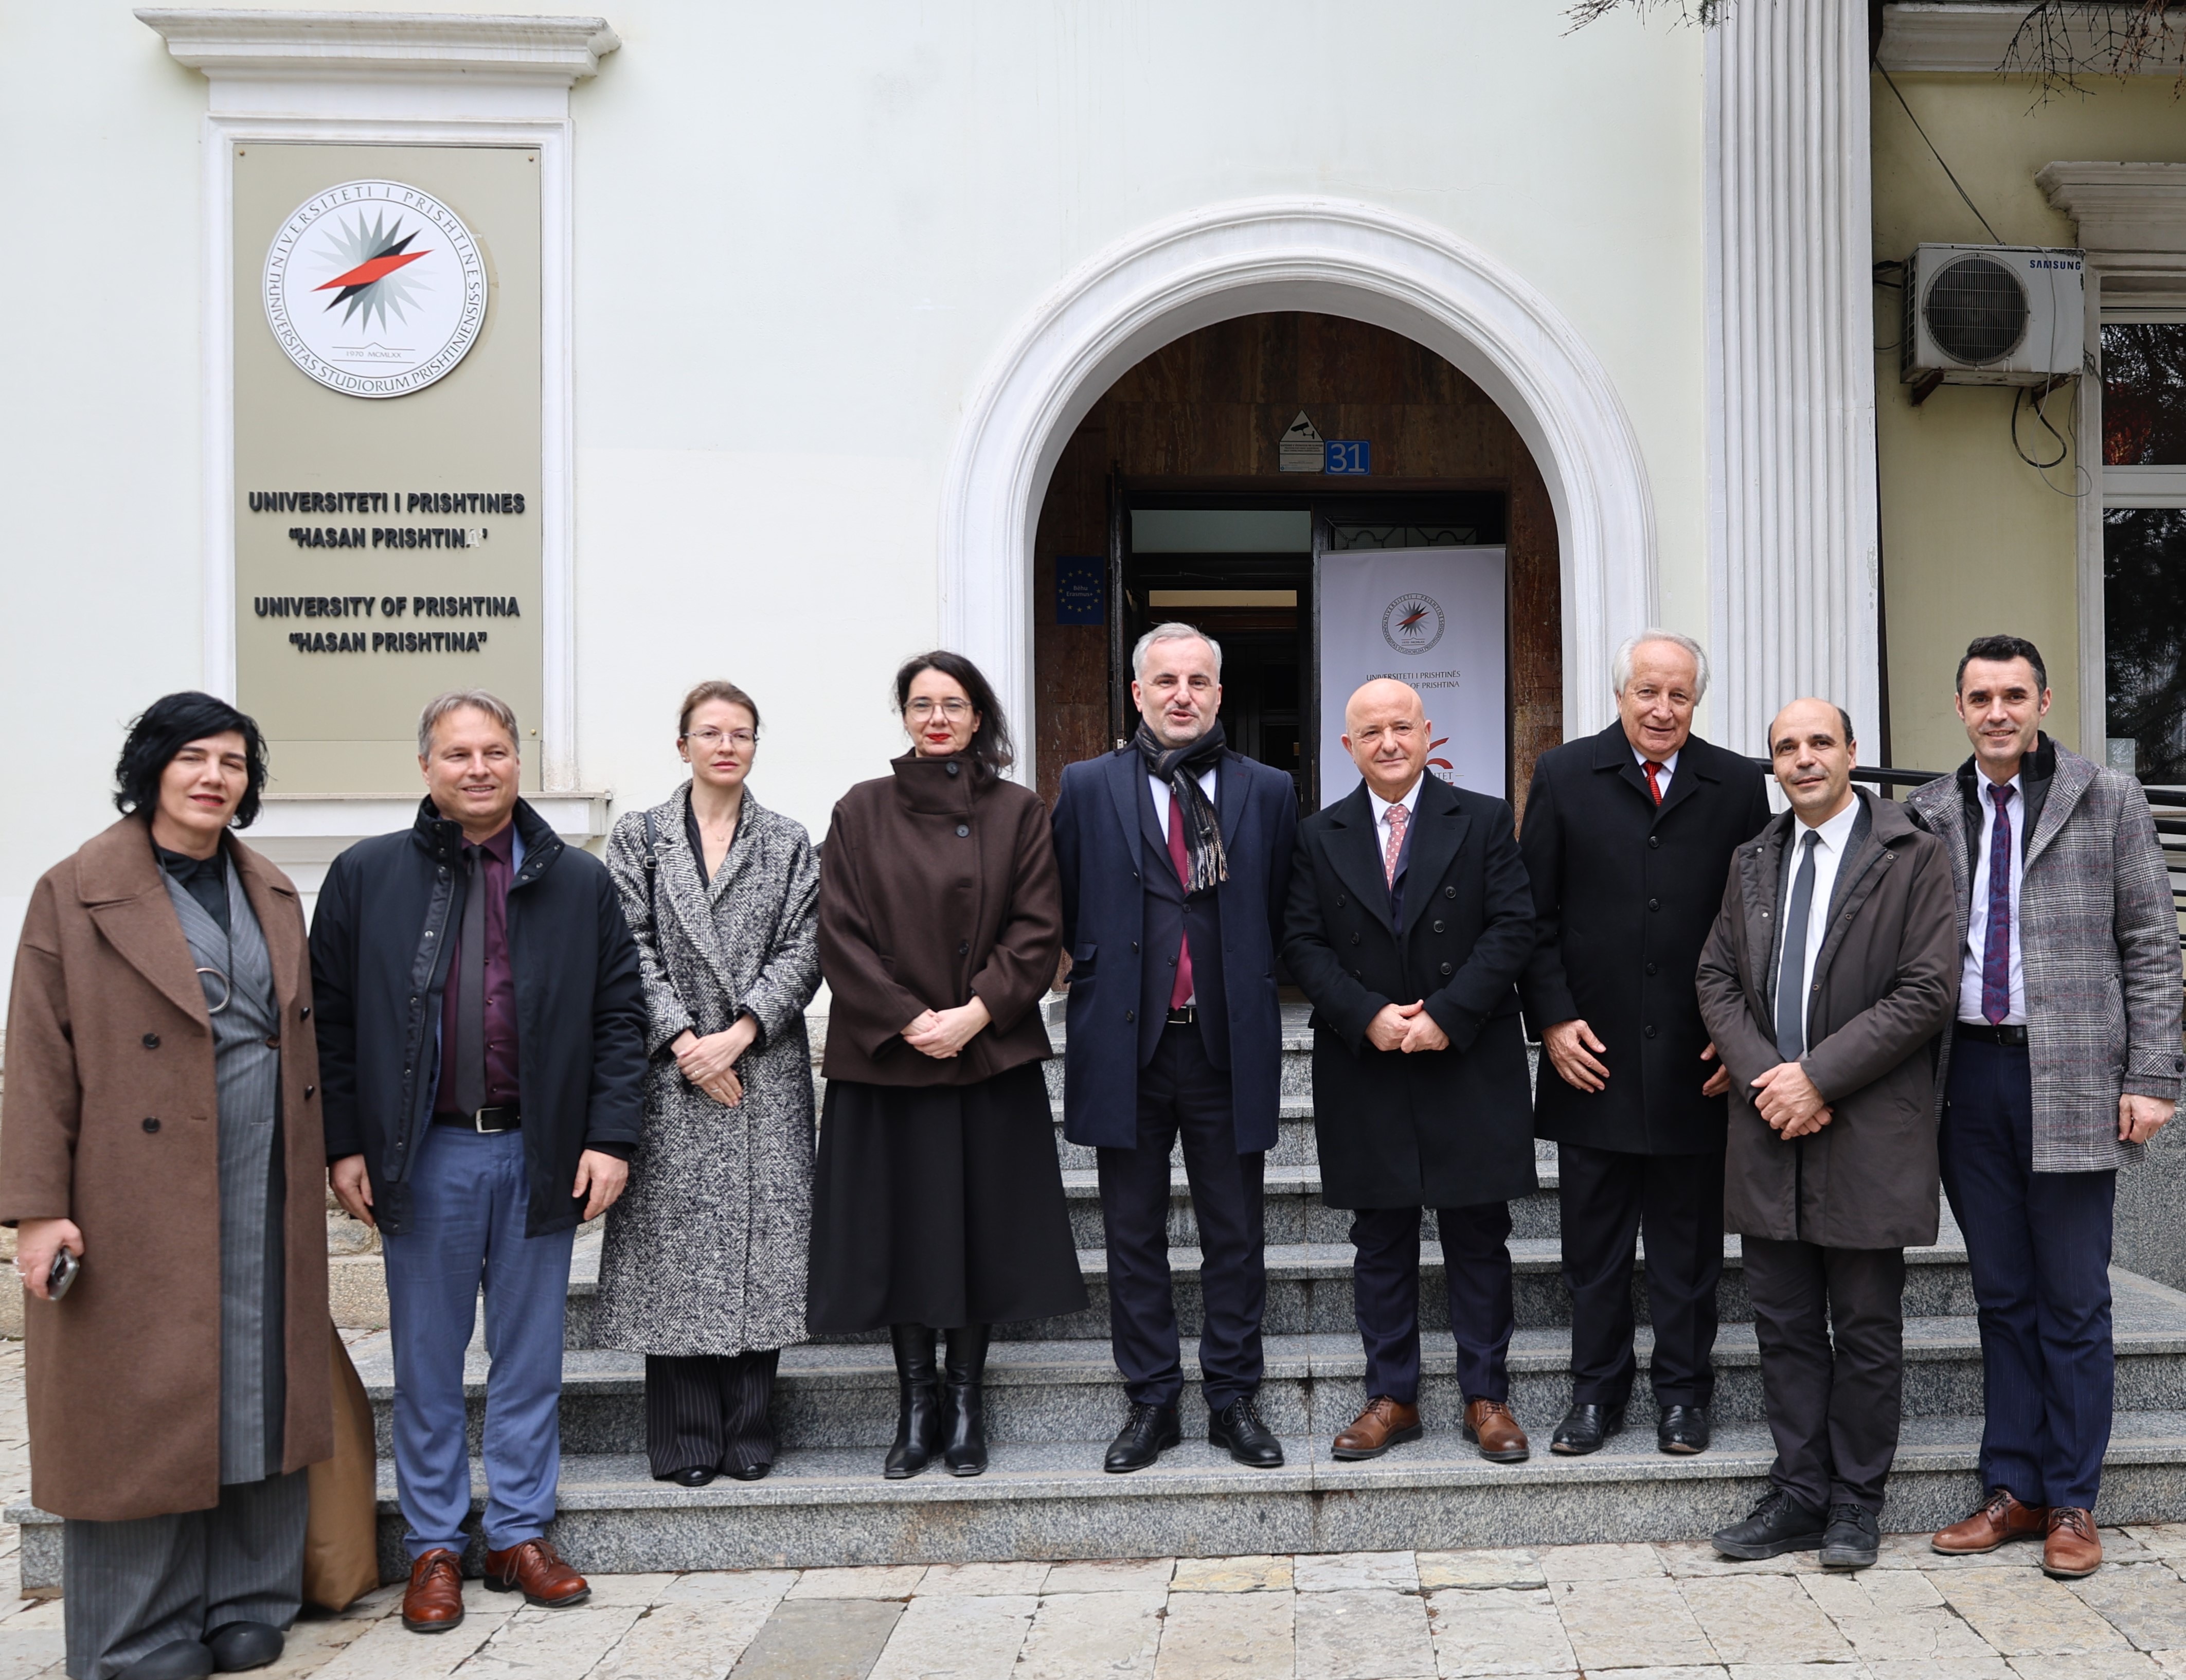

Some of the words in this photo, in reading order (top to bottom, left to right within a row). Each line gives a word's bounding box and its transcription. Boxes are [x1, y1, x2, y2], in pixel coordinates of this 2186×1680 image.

[269, 186, 371, 283] UNIVERSITETI
[386, 187, 390, 198] I
[2030, 260, 2081, 270] SAMSUNG
[268, 285, 319, 370] UNIVERSITAS
[318, 366, 410, 391] STUDIORUM
[411, 294, 480, 384] PRISHTINIENSIS
[1330, 443, 1365, 472] 31
[249, 491, 388, 512] UNIVERSITETI
[395, 492, 400, 512] I
[289, 528, 365, 548] “HASAN
[254, 597, 375, 617] UNIVERSITY
[381, 597, 407, 617] OF
[413, 597, 521, 617] PRISHTINA
[289, 632, 366, 652] “HASAN
[372, 632, 487, 653] PRISHTINA”
[1420, 670, 1461, 678] PRISHTINËS
